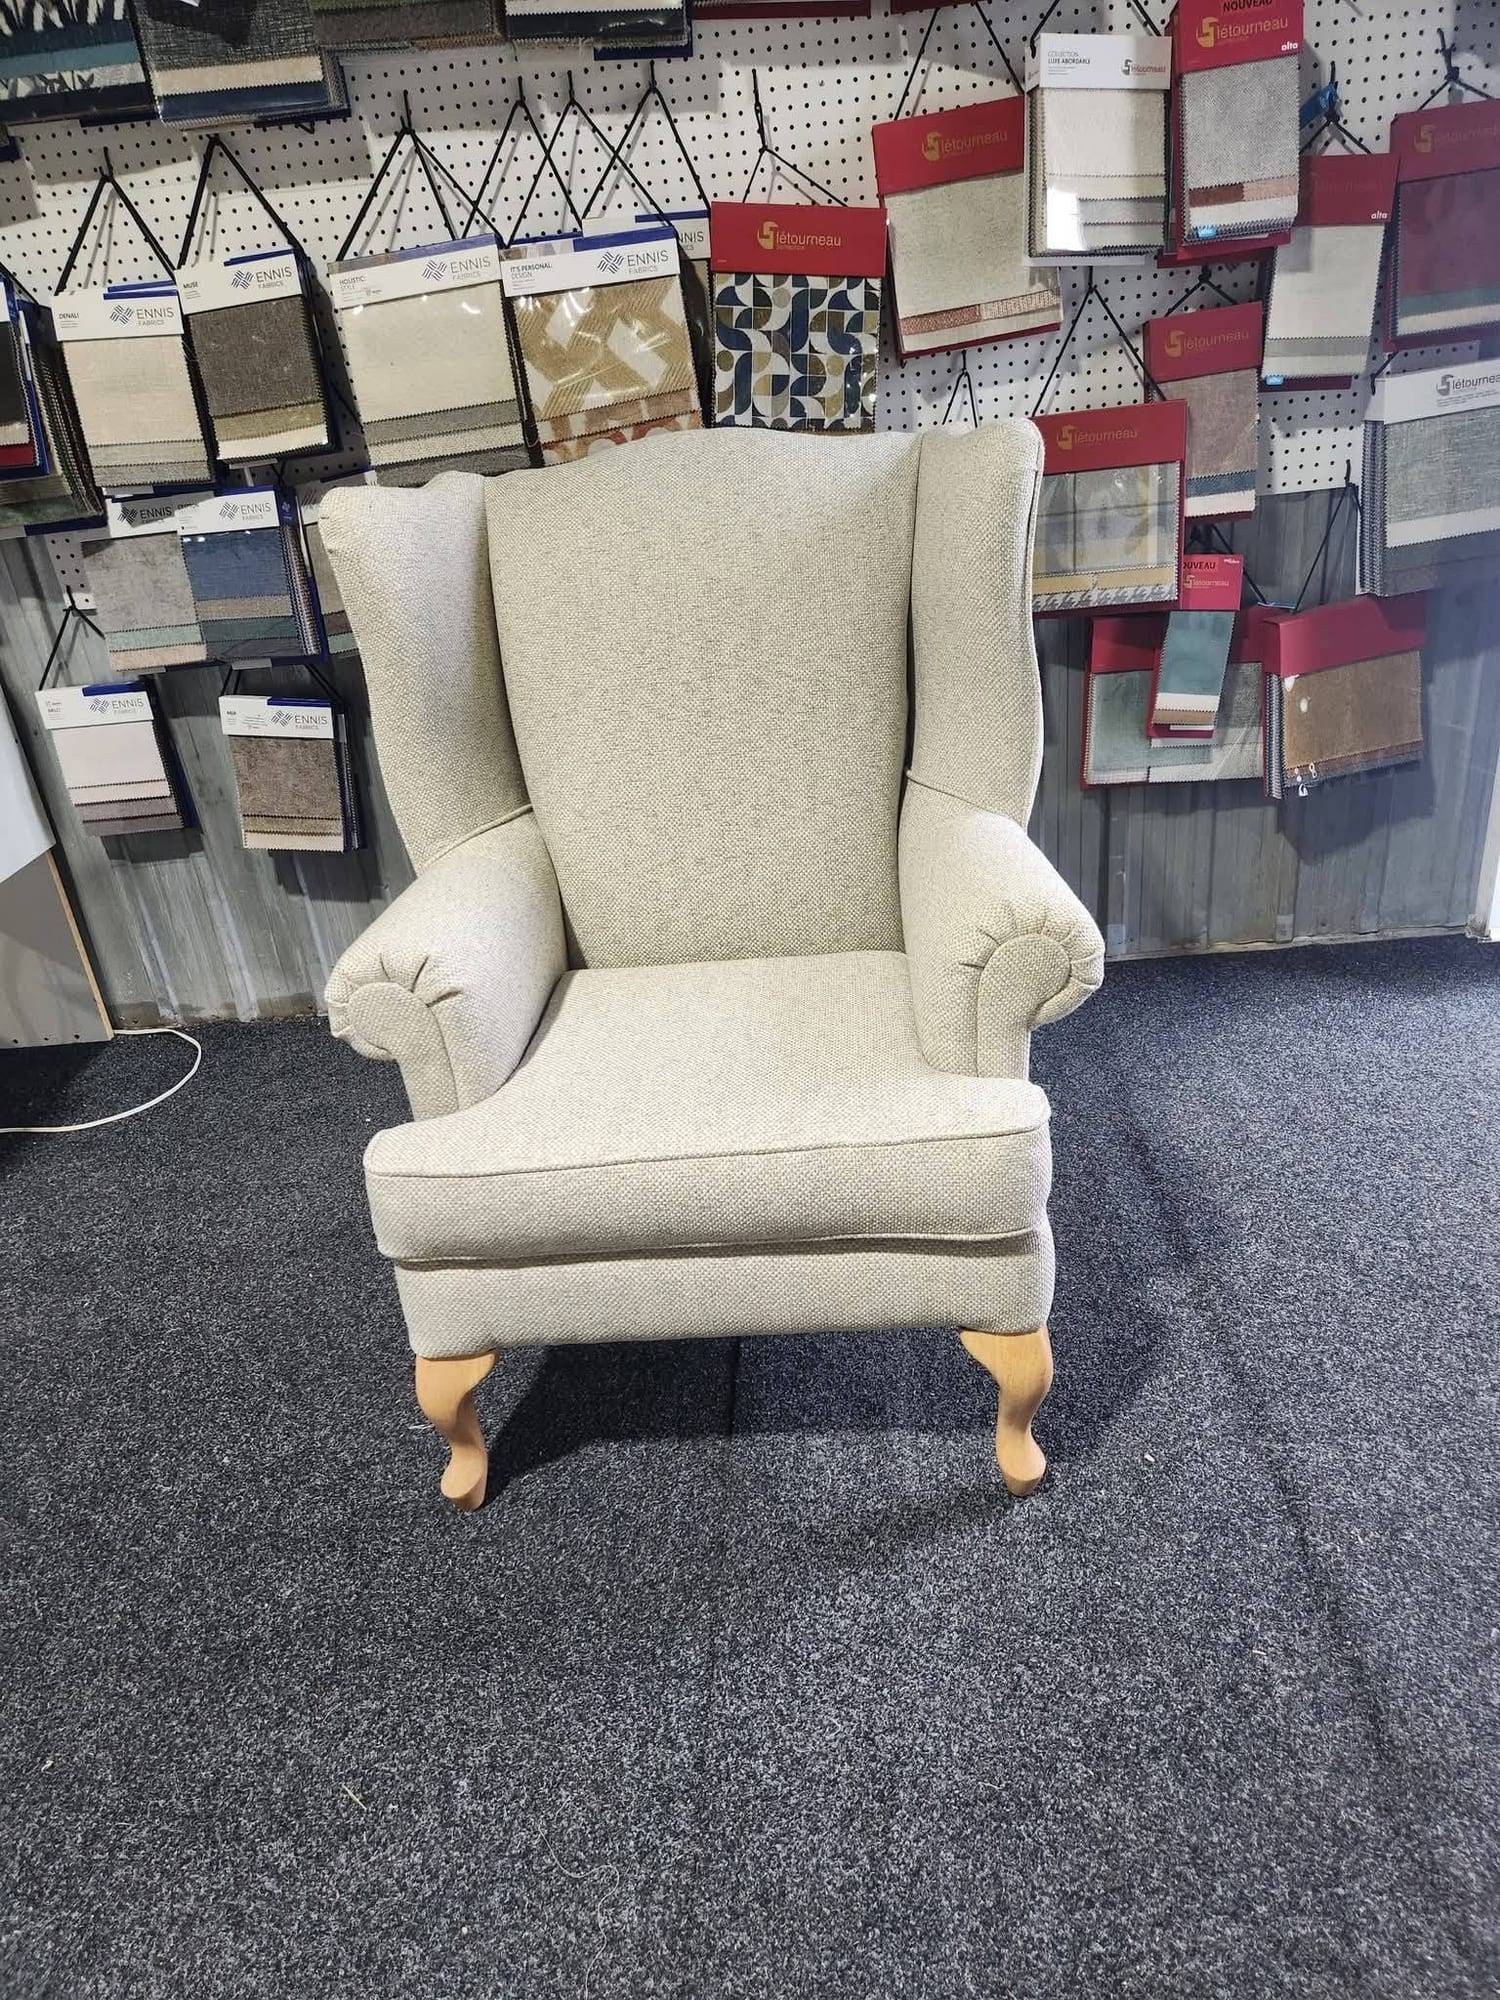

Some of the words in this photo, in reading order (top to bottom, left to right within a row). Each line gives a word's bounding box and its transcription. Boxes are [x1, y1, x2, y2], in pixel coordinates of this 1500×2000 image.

[1223, 0, 1272, 11] NOUVEAU
[1217, 17, 1288, 39] létourneau
[1281, 41, 1298, 51] alta
[1371, 210, 1387, 219] alta
[678, 231, 704, 243] NNIS
[776, 231, 842, 247] létourneau
[627, 250, 669, 267] ENNIS
[450, 256, 491, 274] ENNIS
[628, 266, 658, 274] FABRICS
[255, 266, 293, 283] ENNIS
[136, 307, 174, 320] ENNIS
[140, 506, 173, 519] ENNIS
[241, 502, 271, 514] ENNIS
[112, 698, 144, 709] ENNIS
[294, 715, 328, 725] ENNIS
